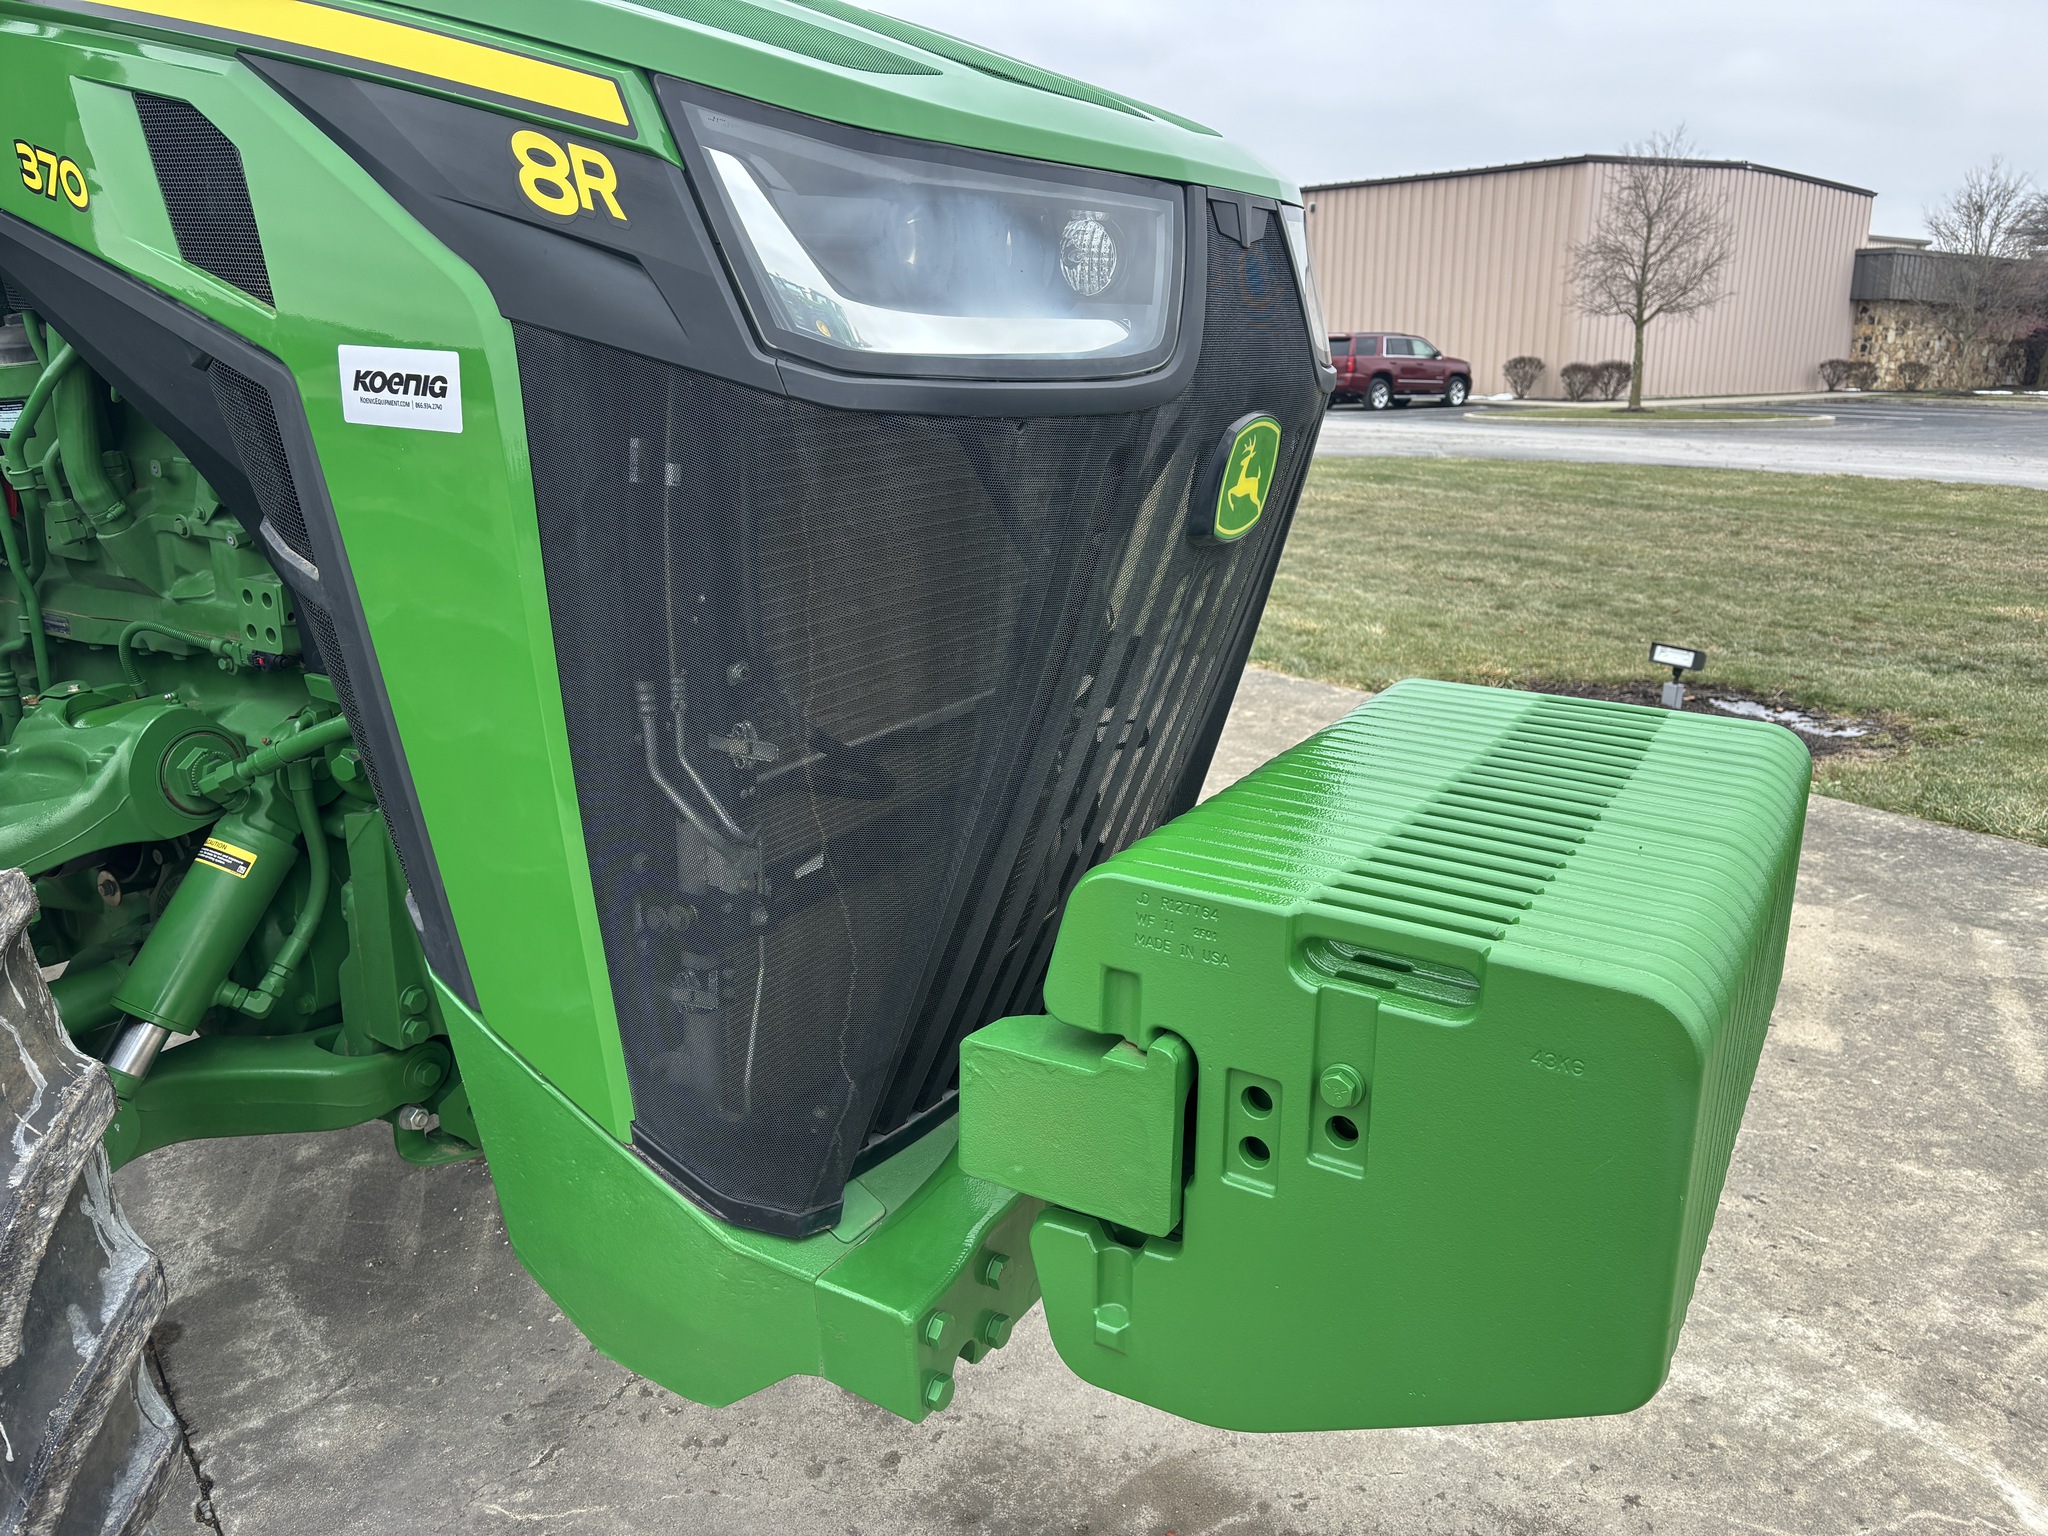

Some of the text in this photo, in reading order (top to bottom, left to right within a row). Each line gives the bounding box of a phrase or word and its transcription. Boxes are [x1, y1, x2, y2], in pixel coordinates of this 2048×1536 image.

[13, 138, 90, 212] 370
[511, 130, 628, 221] 8R
[1134, 933, 1230, 968] MADE IN USA
[1530, 1049, 1585, 1077] 43KG
